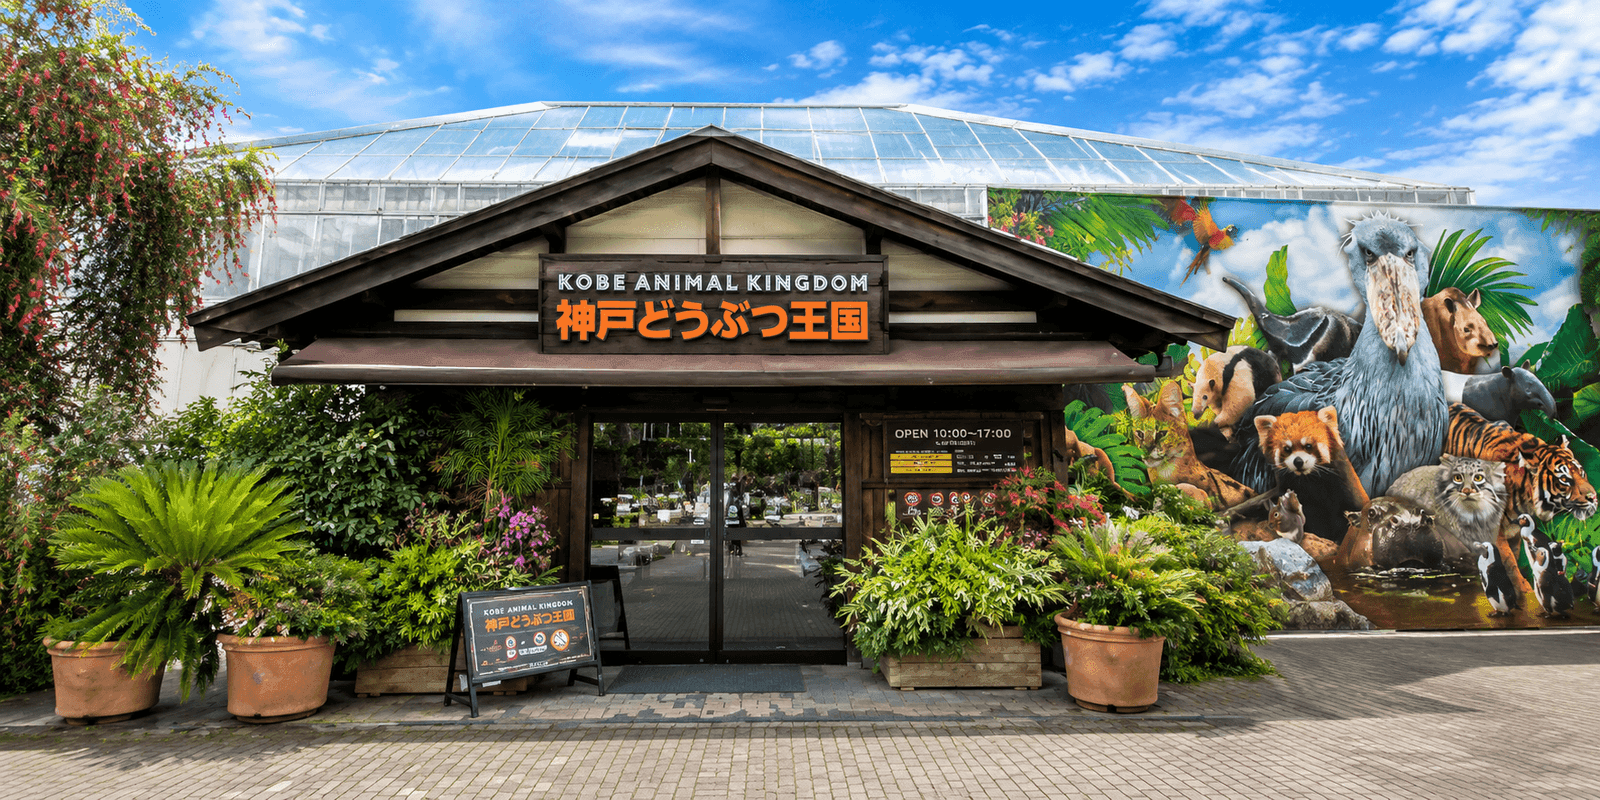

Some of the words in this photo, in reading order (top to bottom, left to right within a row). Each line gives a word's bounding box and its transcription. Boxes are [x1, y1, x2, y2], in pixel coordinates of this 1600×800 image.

[558, 273, 626, 291] KOBE
[634, 273, 738, 291] ANIMAL
[747, 273, 869, 291] KINGDOM
[556, 299, 869, 340] 神戸どうぶつ王国
[895, 429, 928, 438] OPEN
[484, 607, 504, 616] KOBE
[507, 605, 537, 613] ANIMAL
